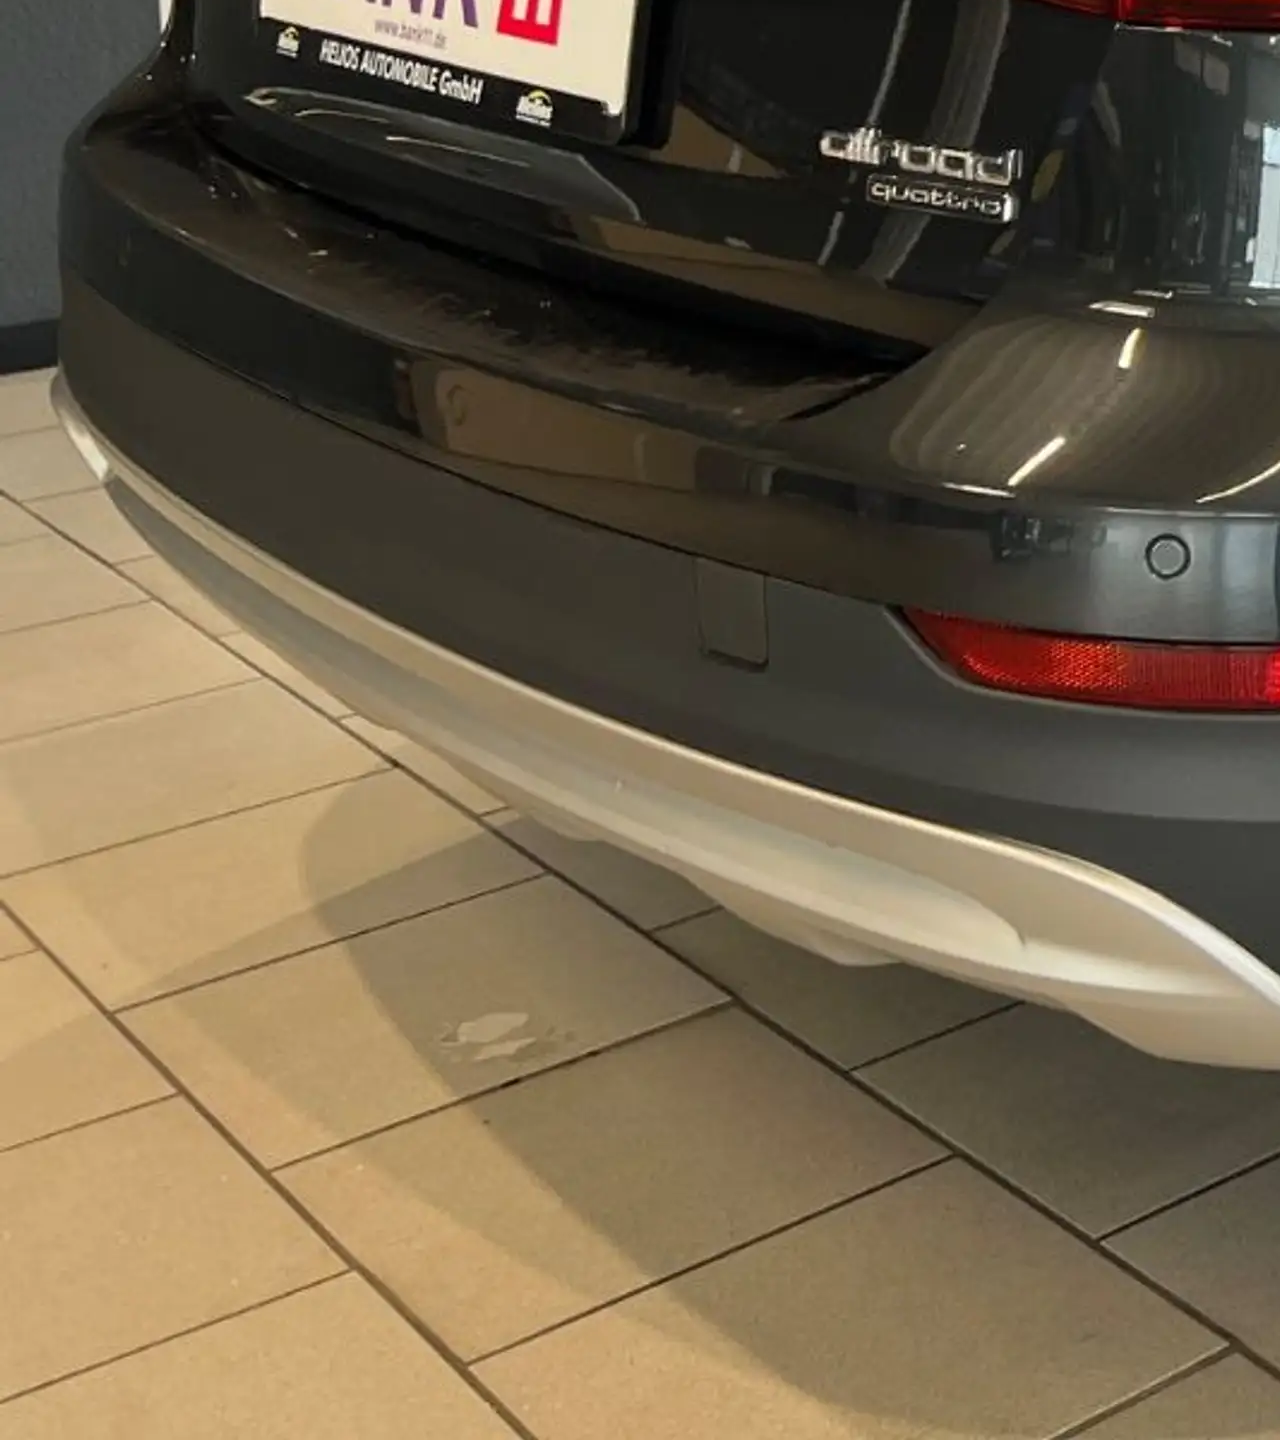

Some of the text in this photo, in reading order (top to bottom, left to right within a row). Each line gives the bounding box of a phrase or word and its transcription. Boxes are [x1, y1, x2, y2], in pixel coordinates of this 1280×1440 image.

[319, 38, 361, 72] HELIOS
[359, 49, 440, 92] AUTOMOBILE
[438, 69, 484, 105] GmbH
[819, 125, 1020, 187] allroad
[870, 181, 1002, 217] quattro
